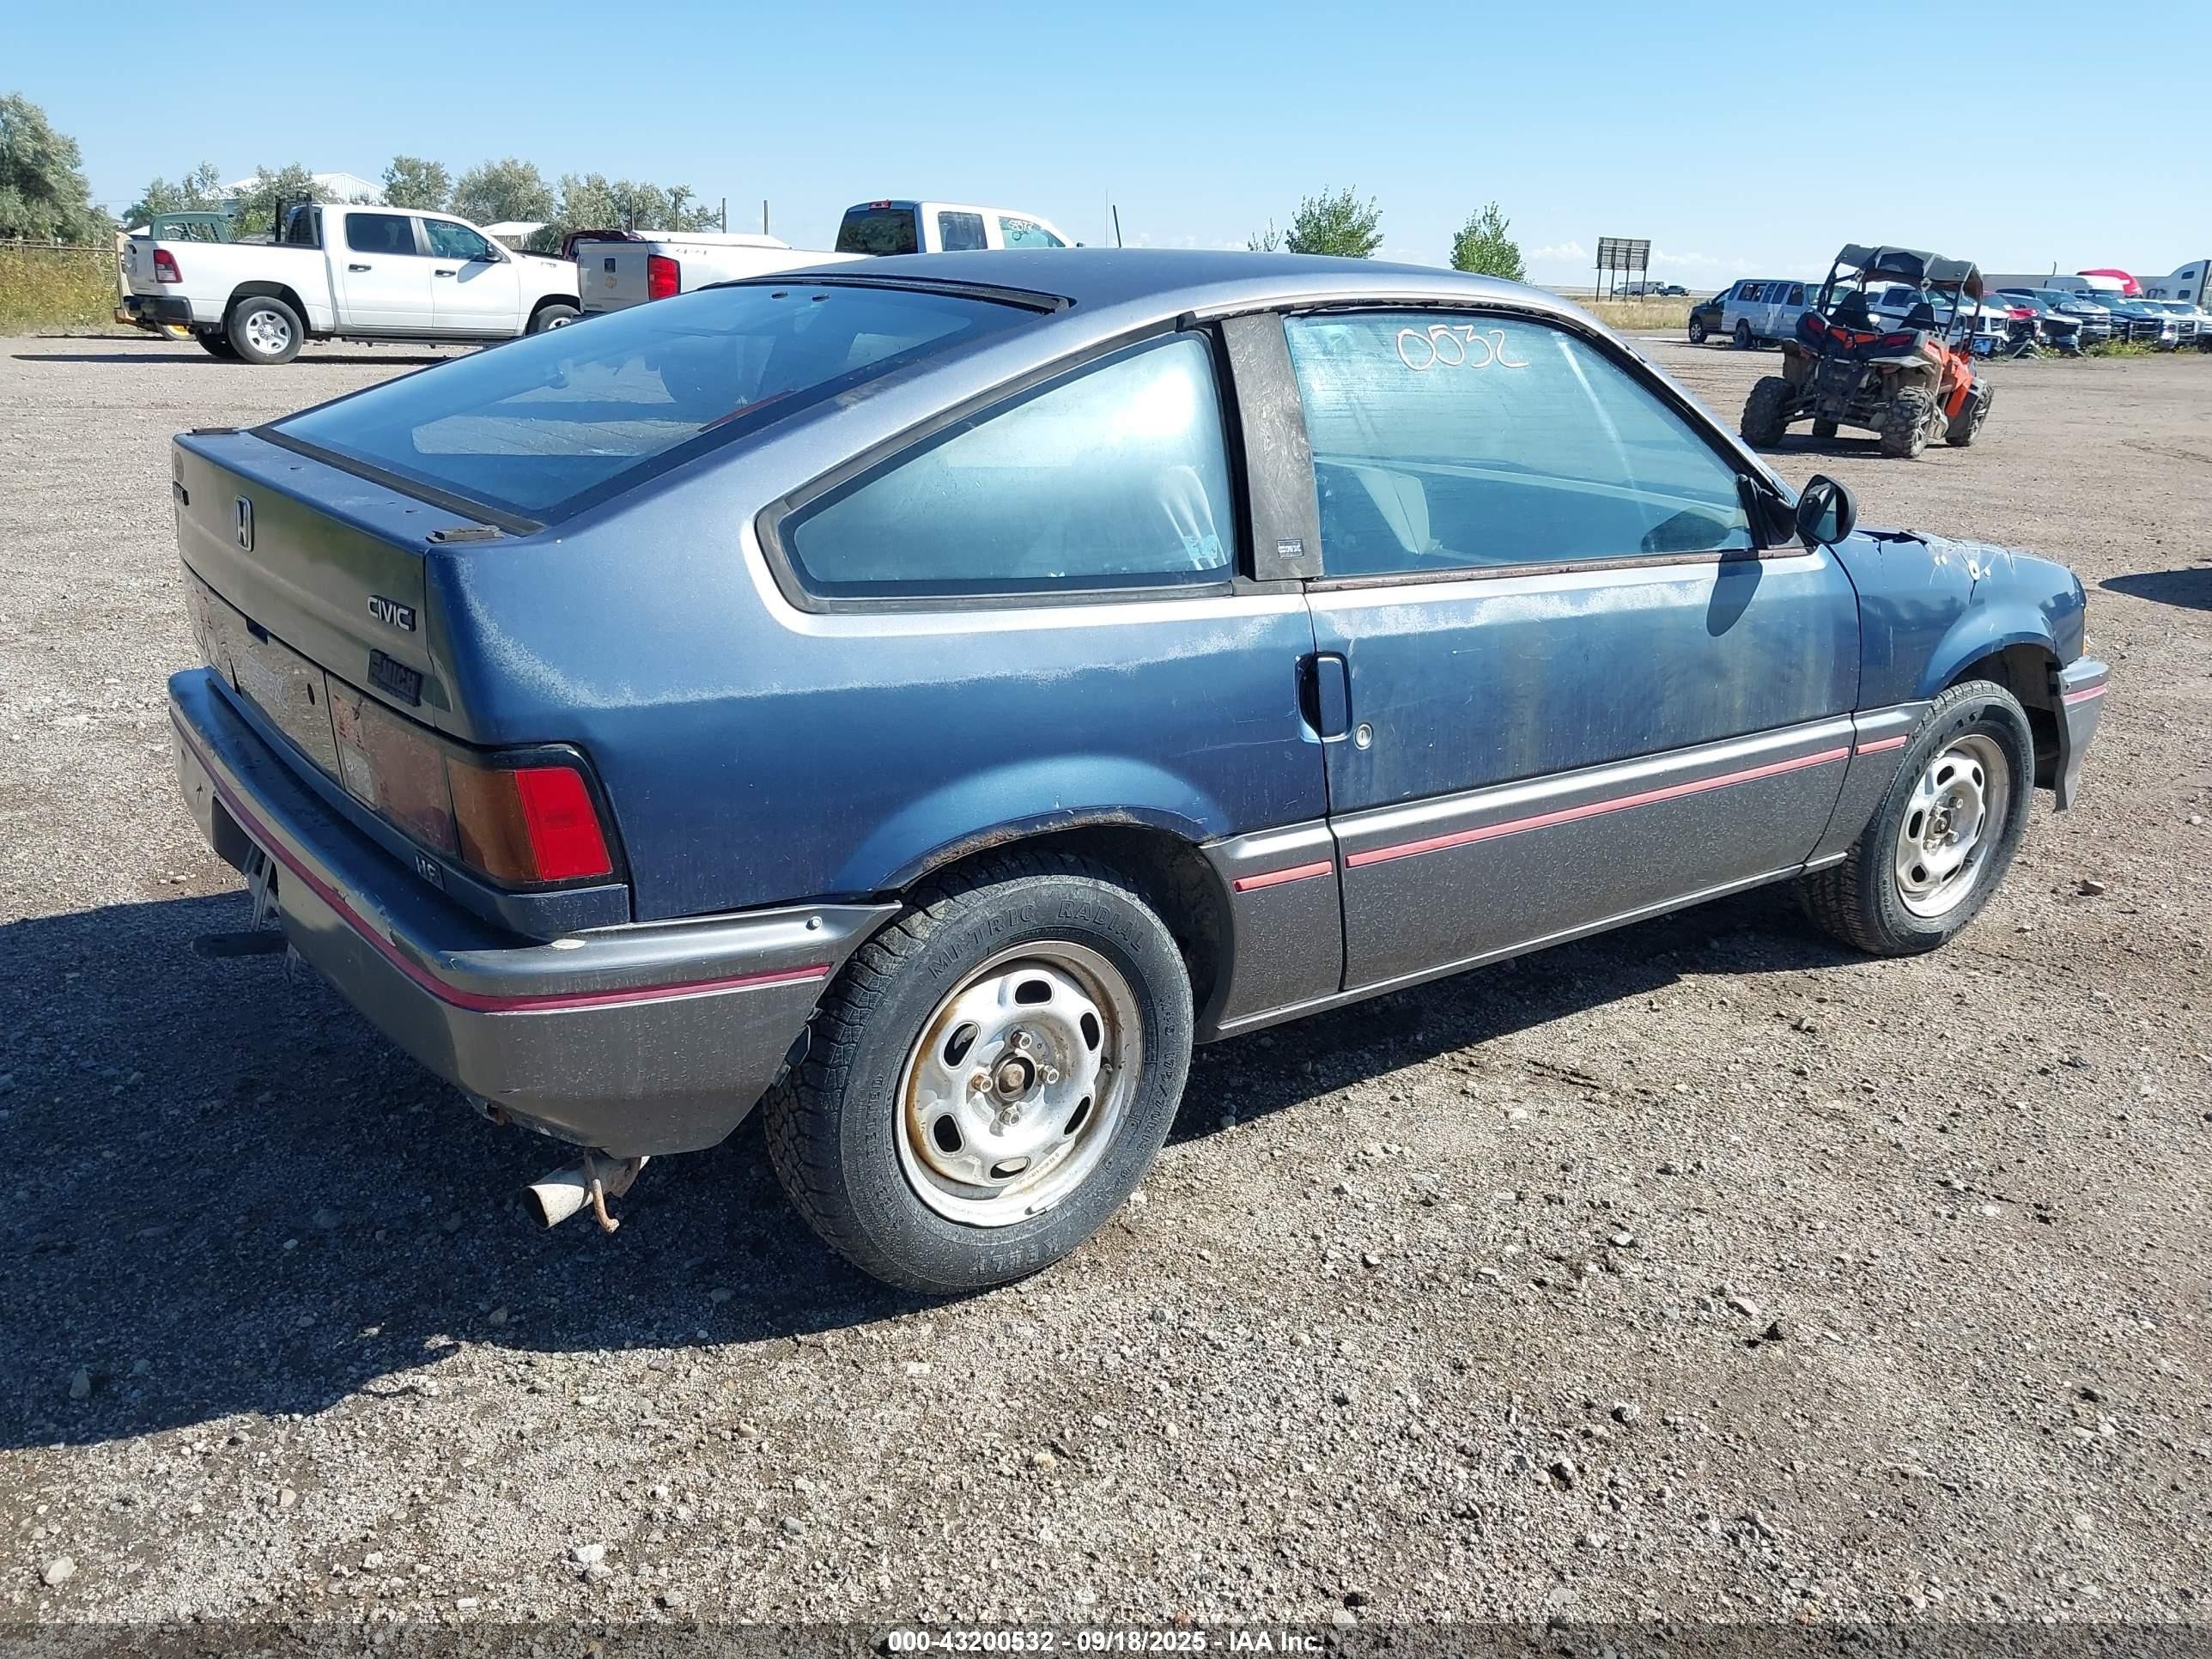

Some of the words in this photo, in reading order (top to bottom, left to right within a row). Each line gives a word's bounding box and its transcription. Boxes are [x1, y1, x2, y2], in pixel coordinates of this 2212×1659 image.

[1396, 324, 1530, 371] 0532
[368, 596, 410, 630] CIVIC
[927, 904, 1035, 979] METRIC
[1058, 900, 1144, 952] RADIAL
[865, 1075, 884, 1159] BELTED
[969, 1235, 1060, 1275] KELLY
